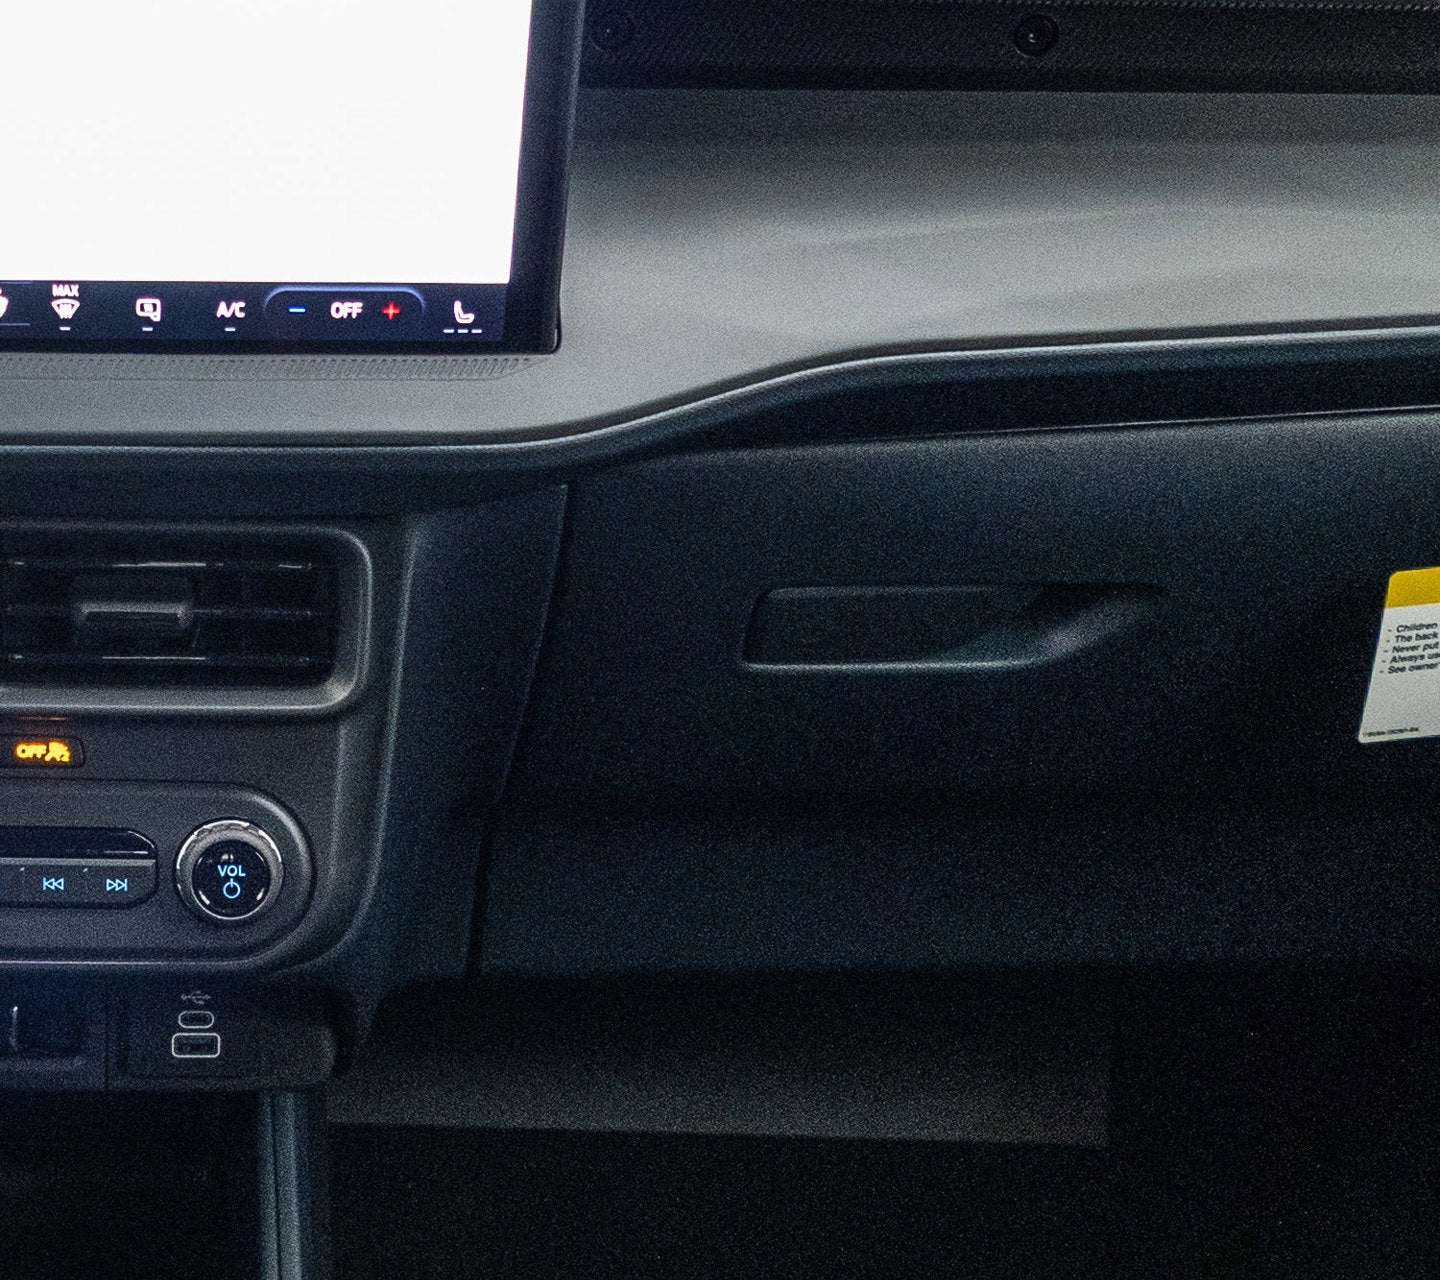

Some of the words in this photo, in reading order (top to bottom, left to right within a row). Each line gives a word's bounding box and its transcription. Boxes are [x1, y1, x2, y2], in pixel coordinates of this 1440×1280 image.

[51, 284, 80, 297] MAX
[216, 301, 246, 318] A/C
[330, 301, 364, 319] OFF
[1396, 622, 1438, 633] Children
[1395, 634, 1413, 643] The
[1415, 631, 1439, 641] back
[1392, 644, 1421, 653] Never
[1422, 641, 1440, 651] put
[1390, 654, 1426, 664] Always
[1388, 665, 1407, 674] See
[16, 744, 47, 759] OFF
[217, 864, 246, 877] VOL
